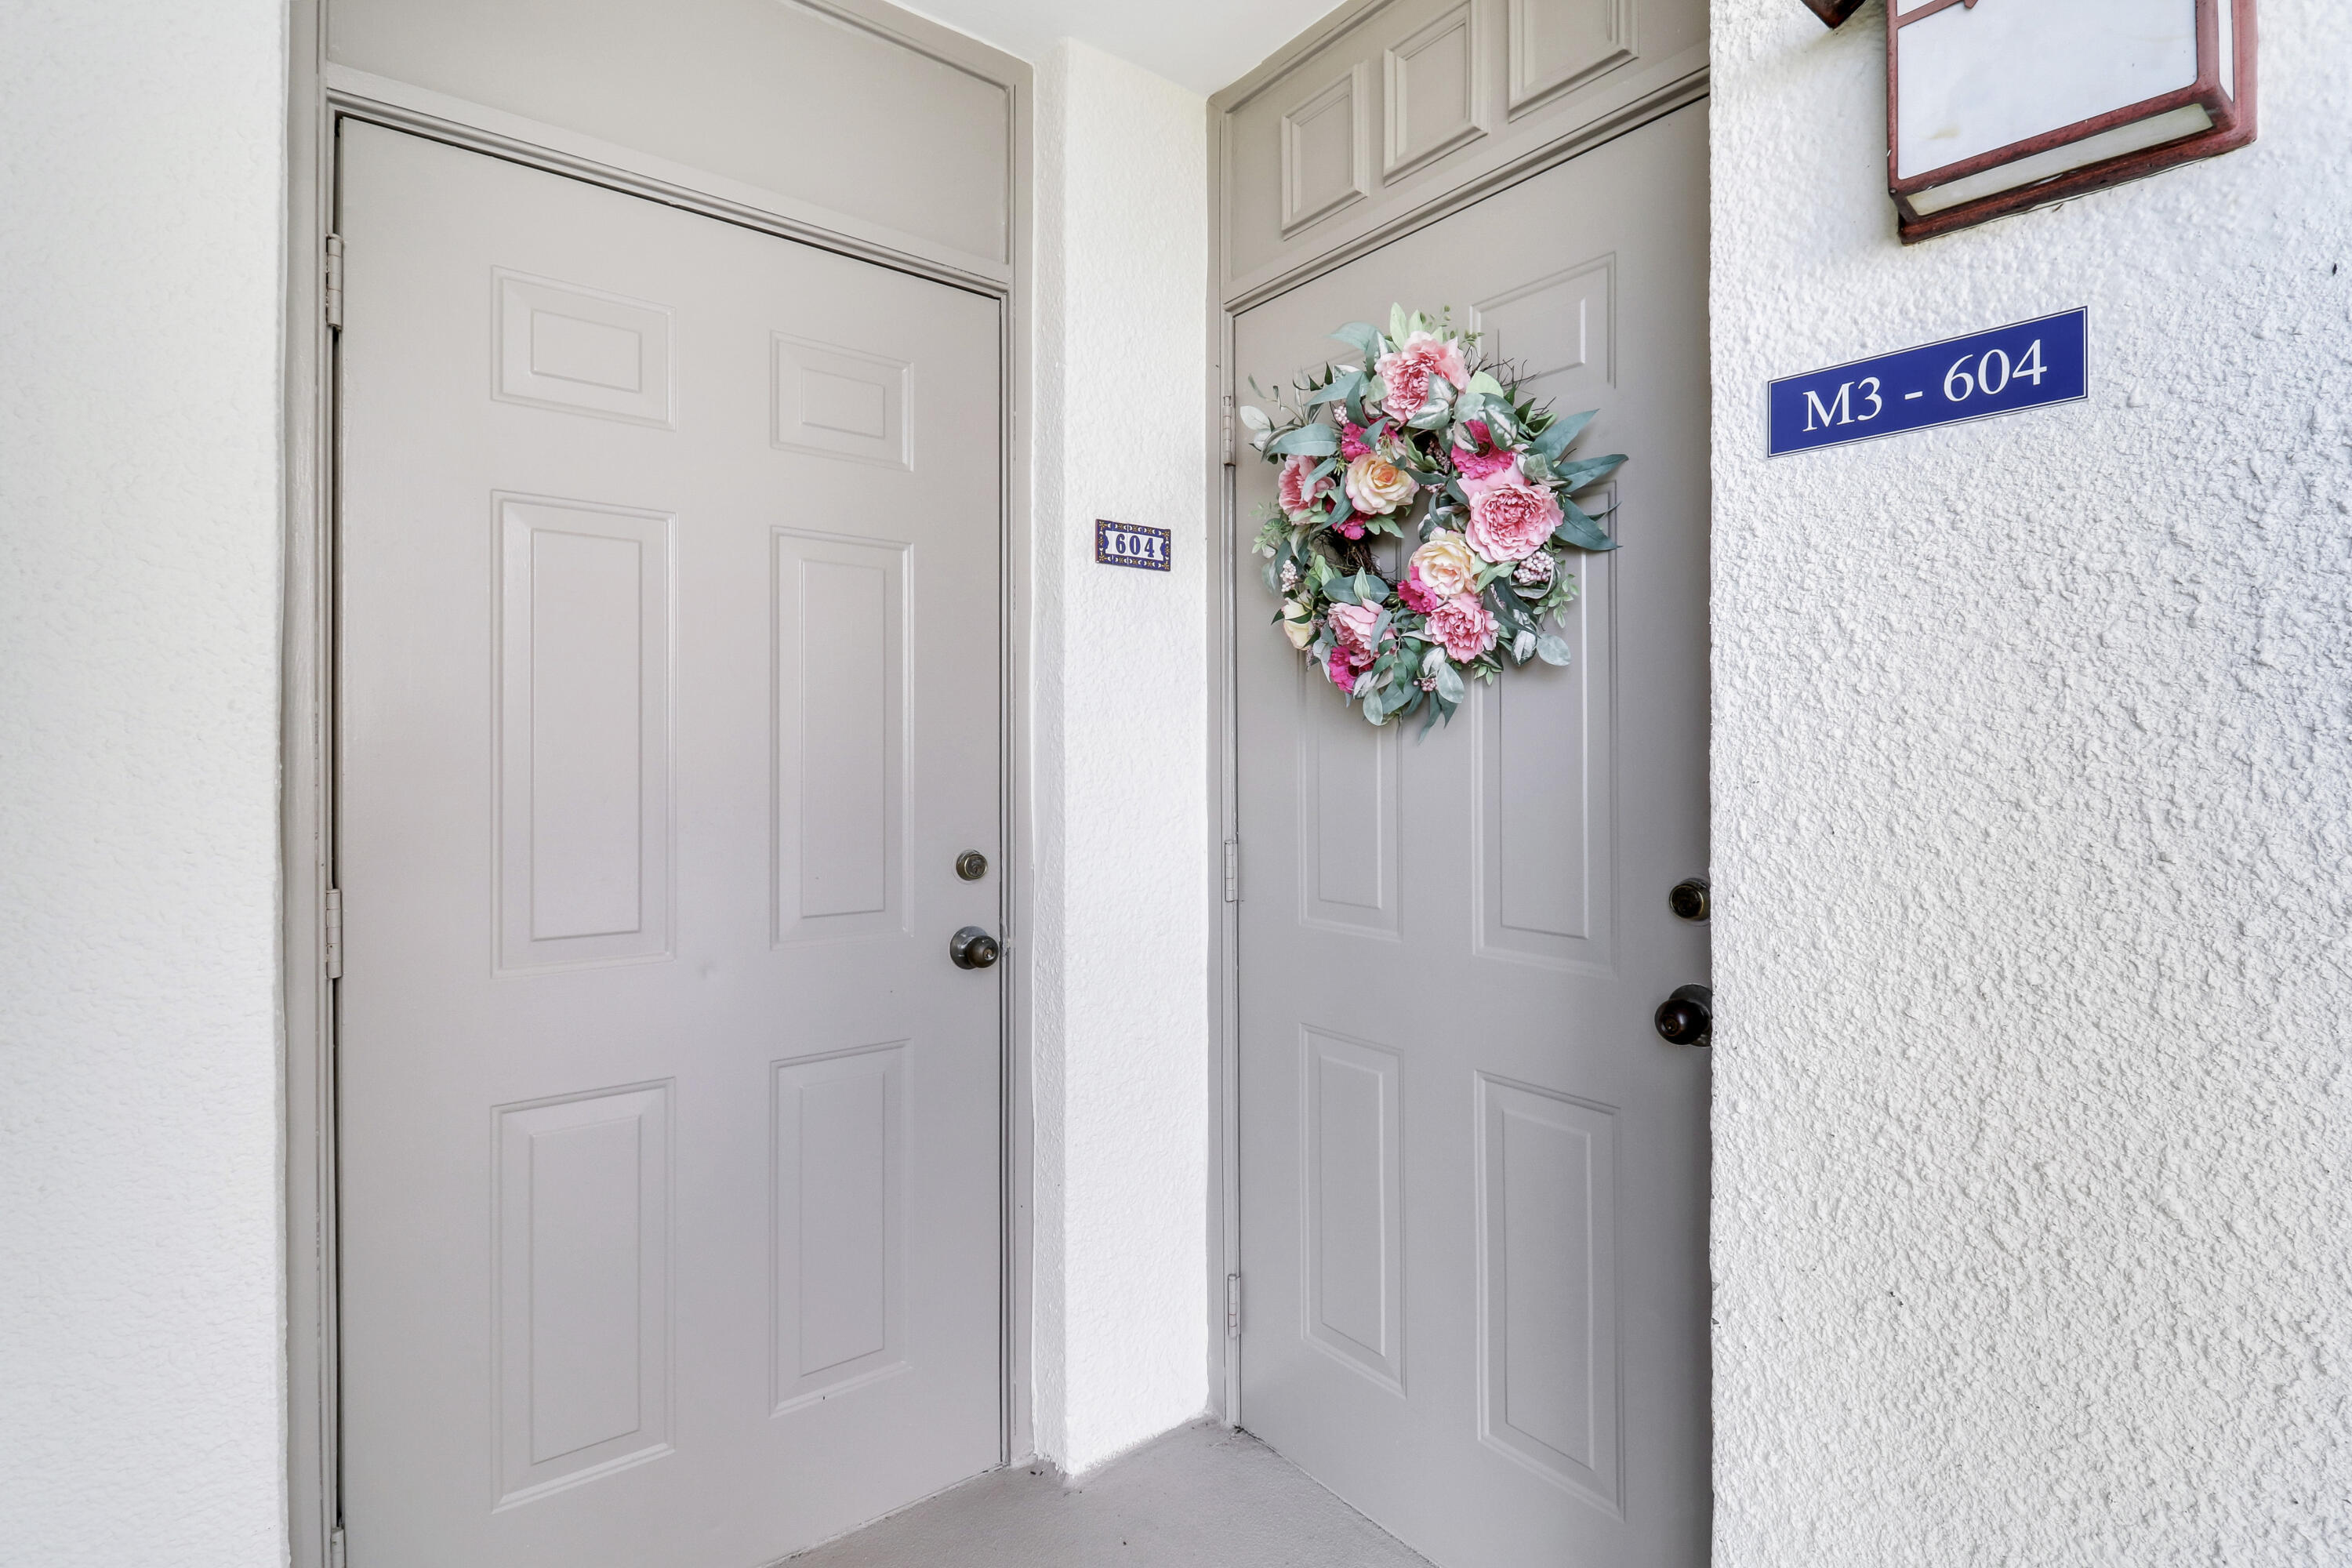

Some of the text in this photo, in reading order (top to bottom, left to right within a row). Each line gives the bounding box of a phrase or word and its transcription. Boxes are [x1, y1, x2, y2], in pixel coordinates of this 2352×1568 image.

[1802, 339, 2048, 432] M3 - 604
[1115, 533, 1155, 557] 604
